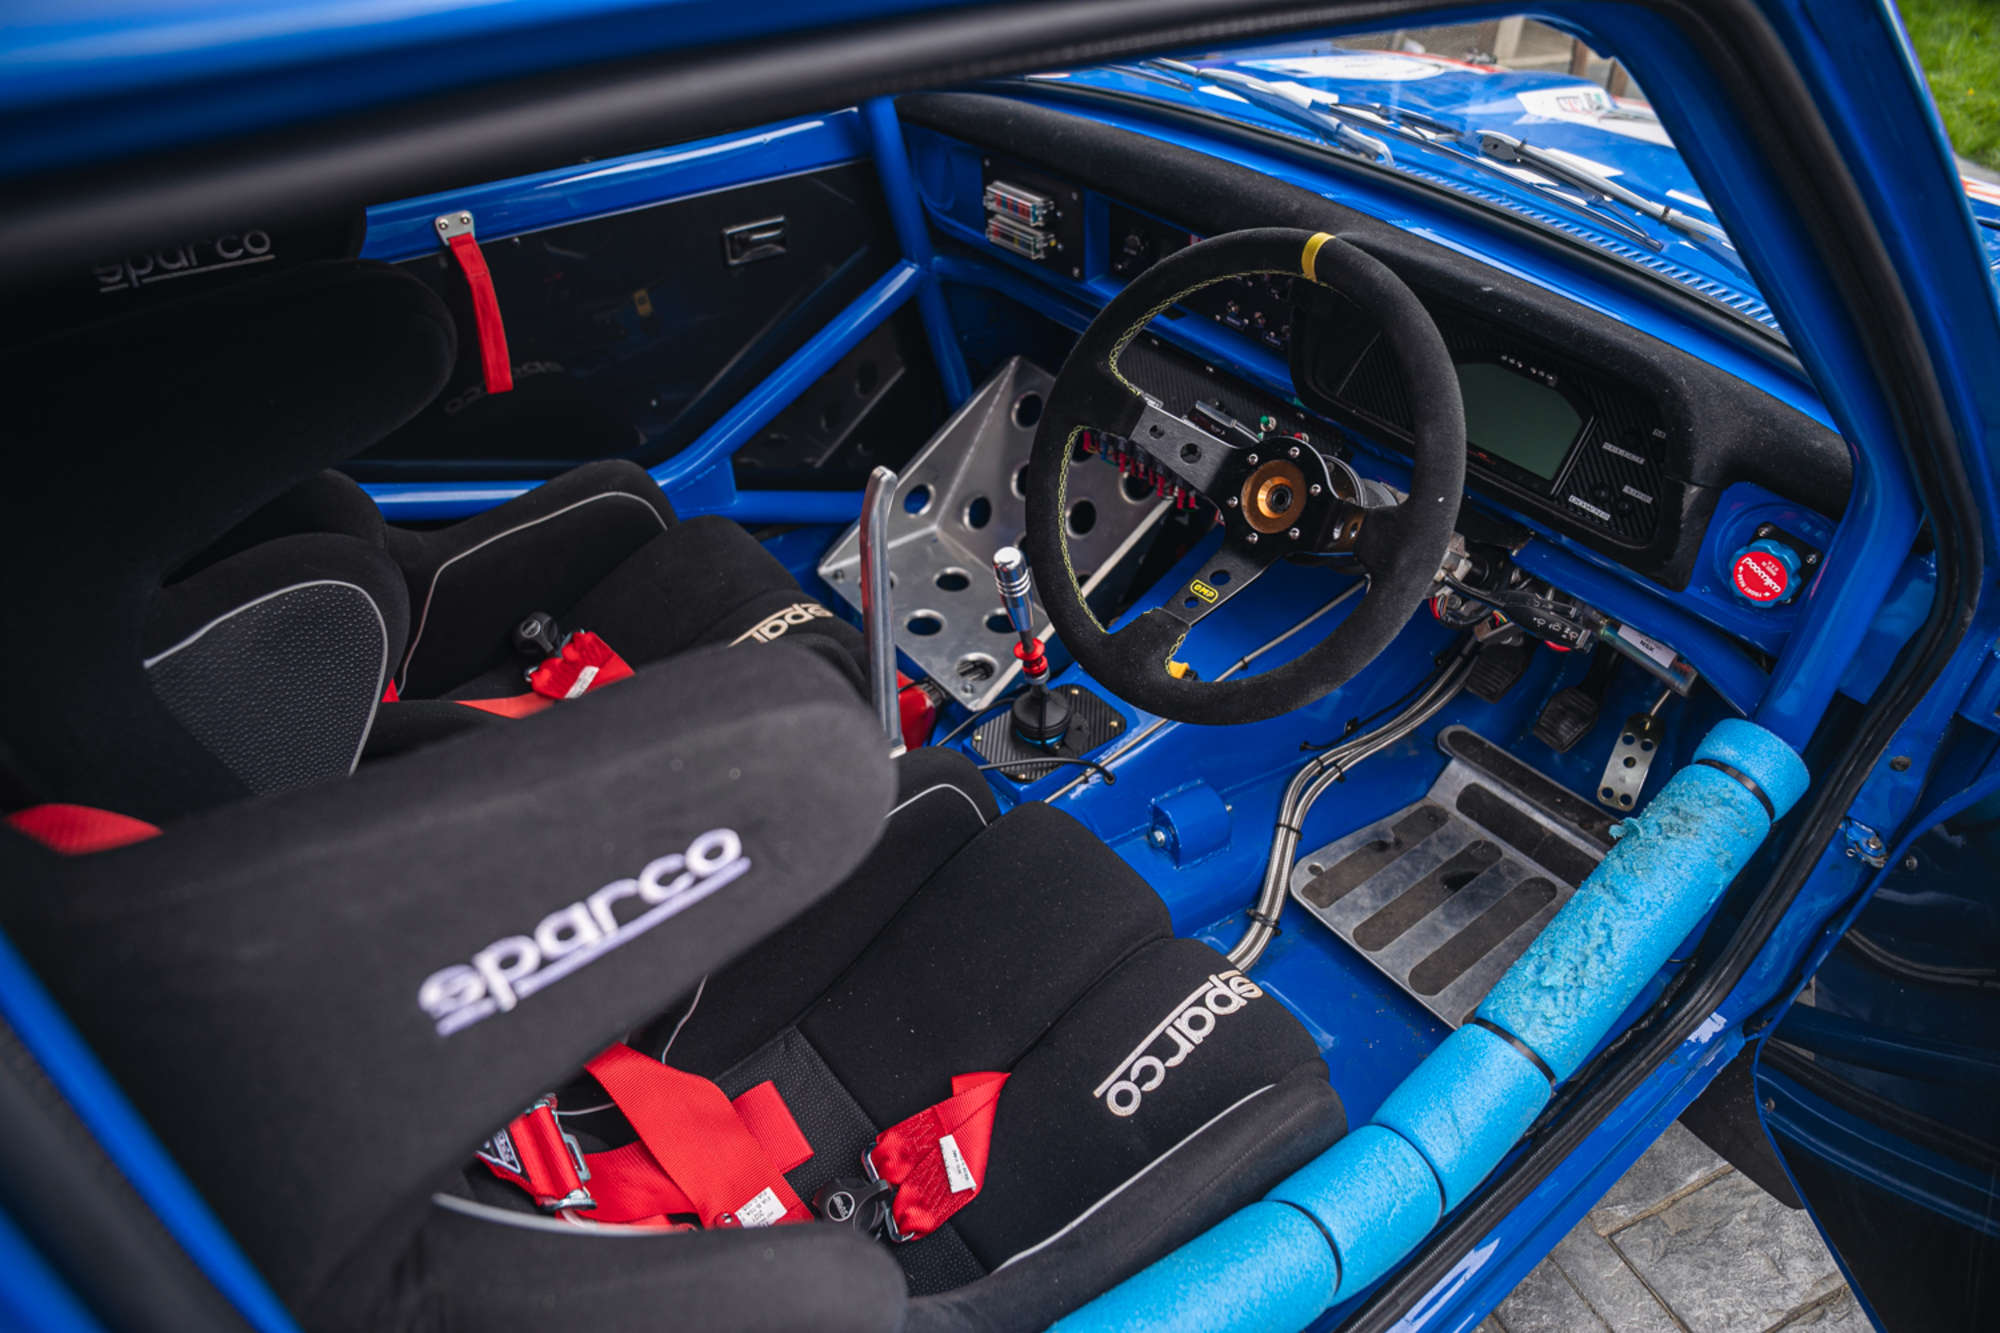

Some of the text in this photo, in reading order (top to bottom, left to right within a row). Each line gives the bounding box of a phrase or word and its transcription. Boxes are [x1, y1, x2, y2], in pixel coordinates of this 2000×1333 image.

[748, 603, 834, 644] spar
[1193, 583, 1216, 599] OMP
[419, 828, 752, 1028] sparco
[1098, 970, 1263, 1117] sparco
